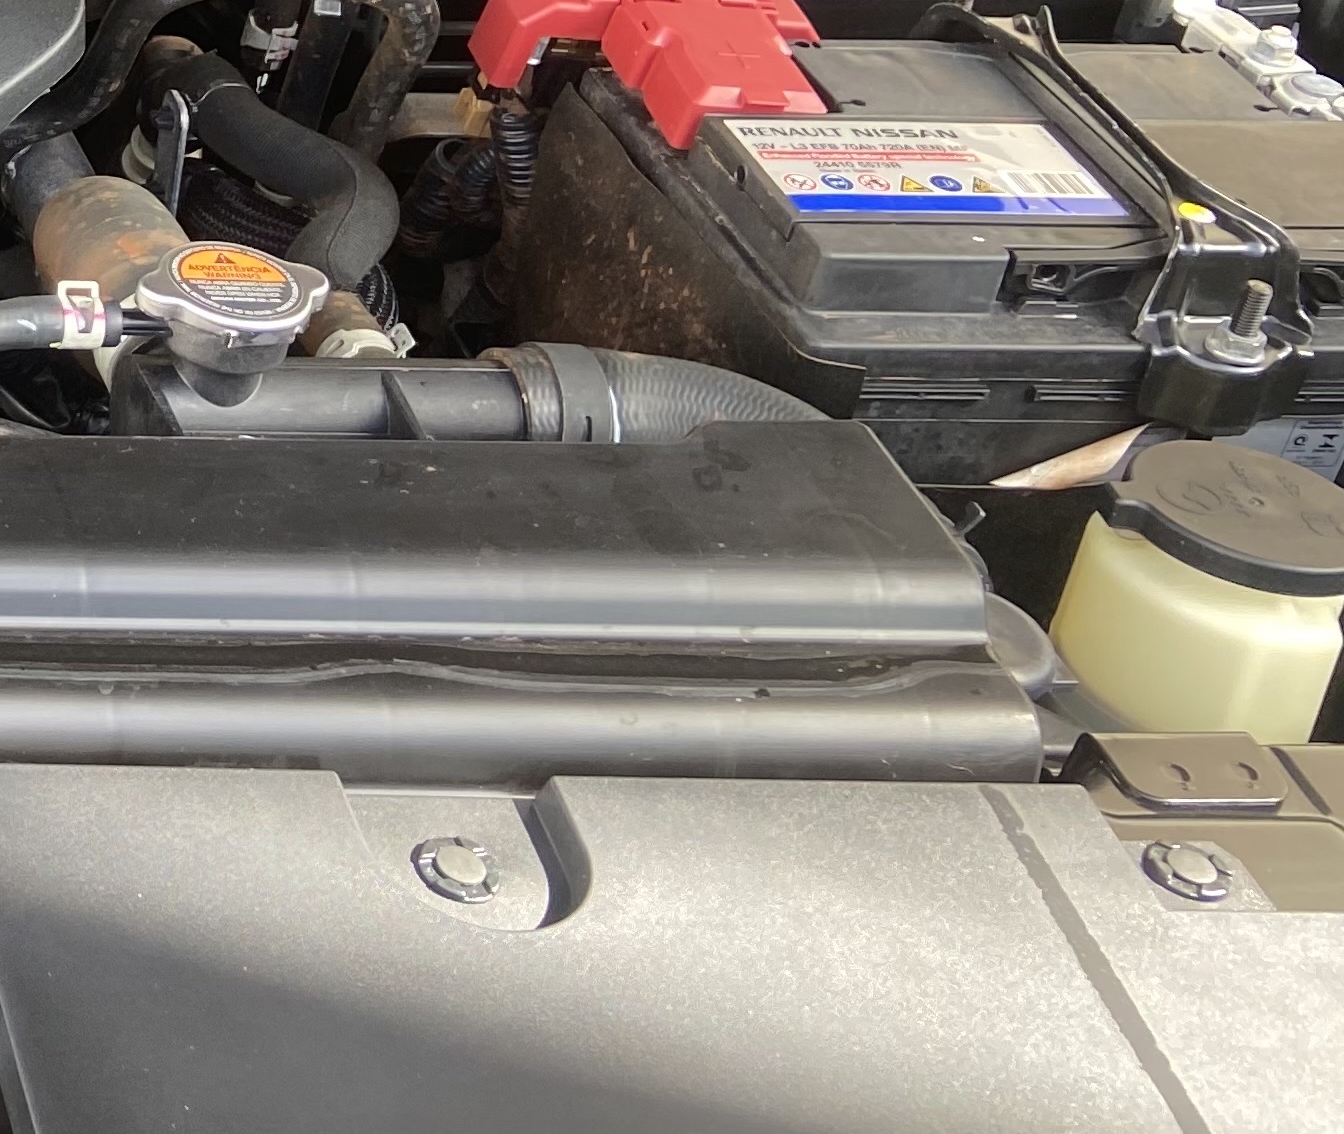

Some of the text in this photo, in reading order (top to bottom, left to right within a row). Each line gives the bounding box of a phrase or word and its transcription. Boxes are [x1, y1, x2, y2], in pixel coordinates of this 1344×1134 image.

[737, 127, 959, 139] RENAULT NISSAN
[202, 272, 262, 280] WARNING
